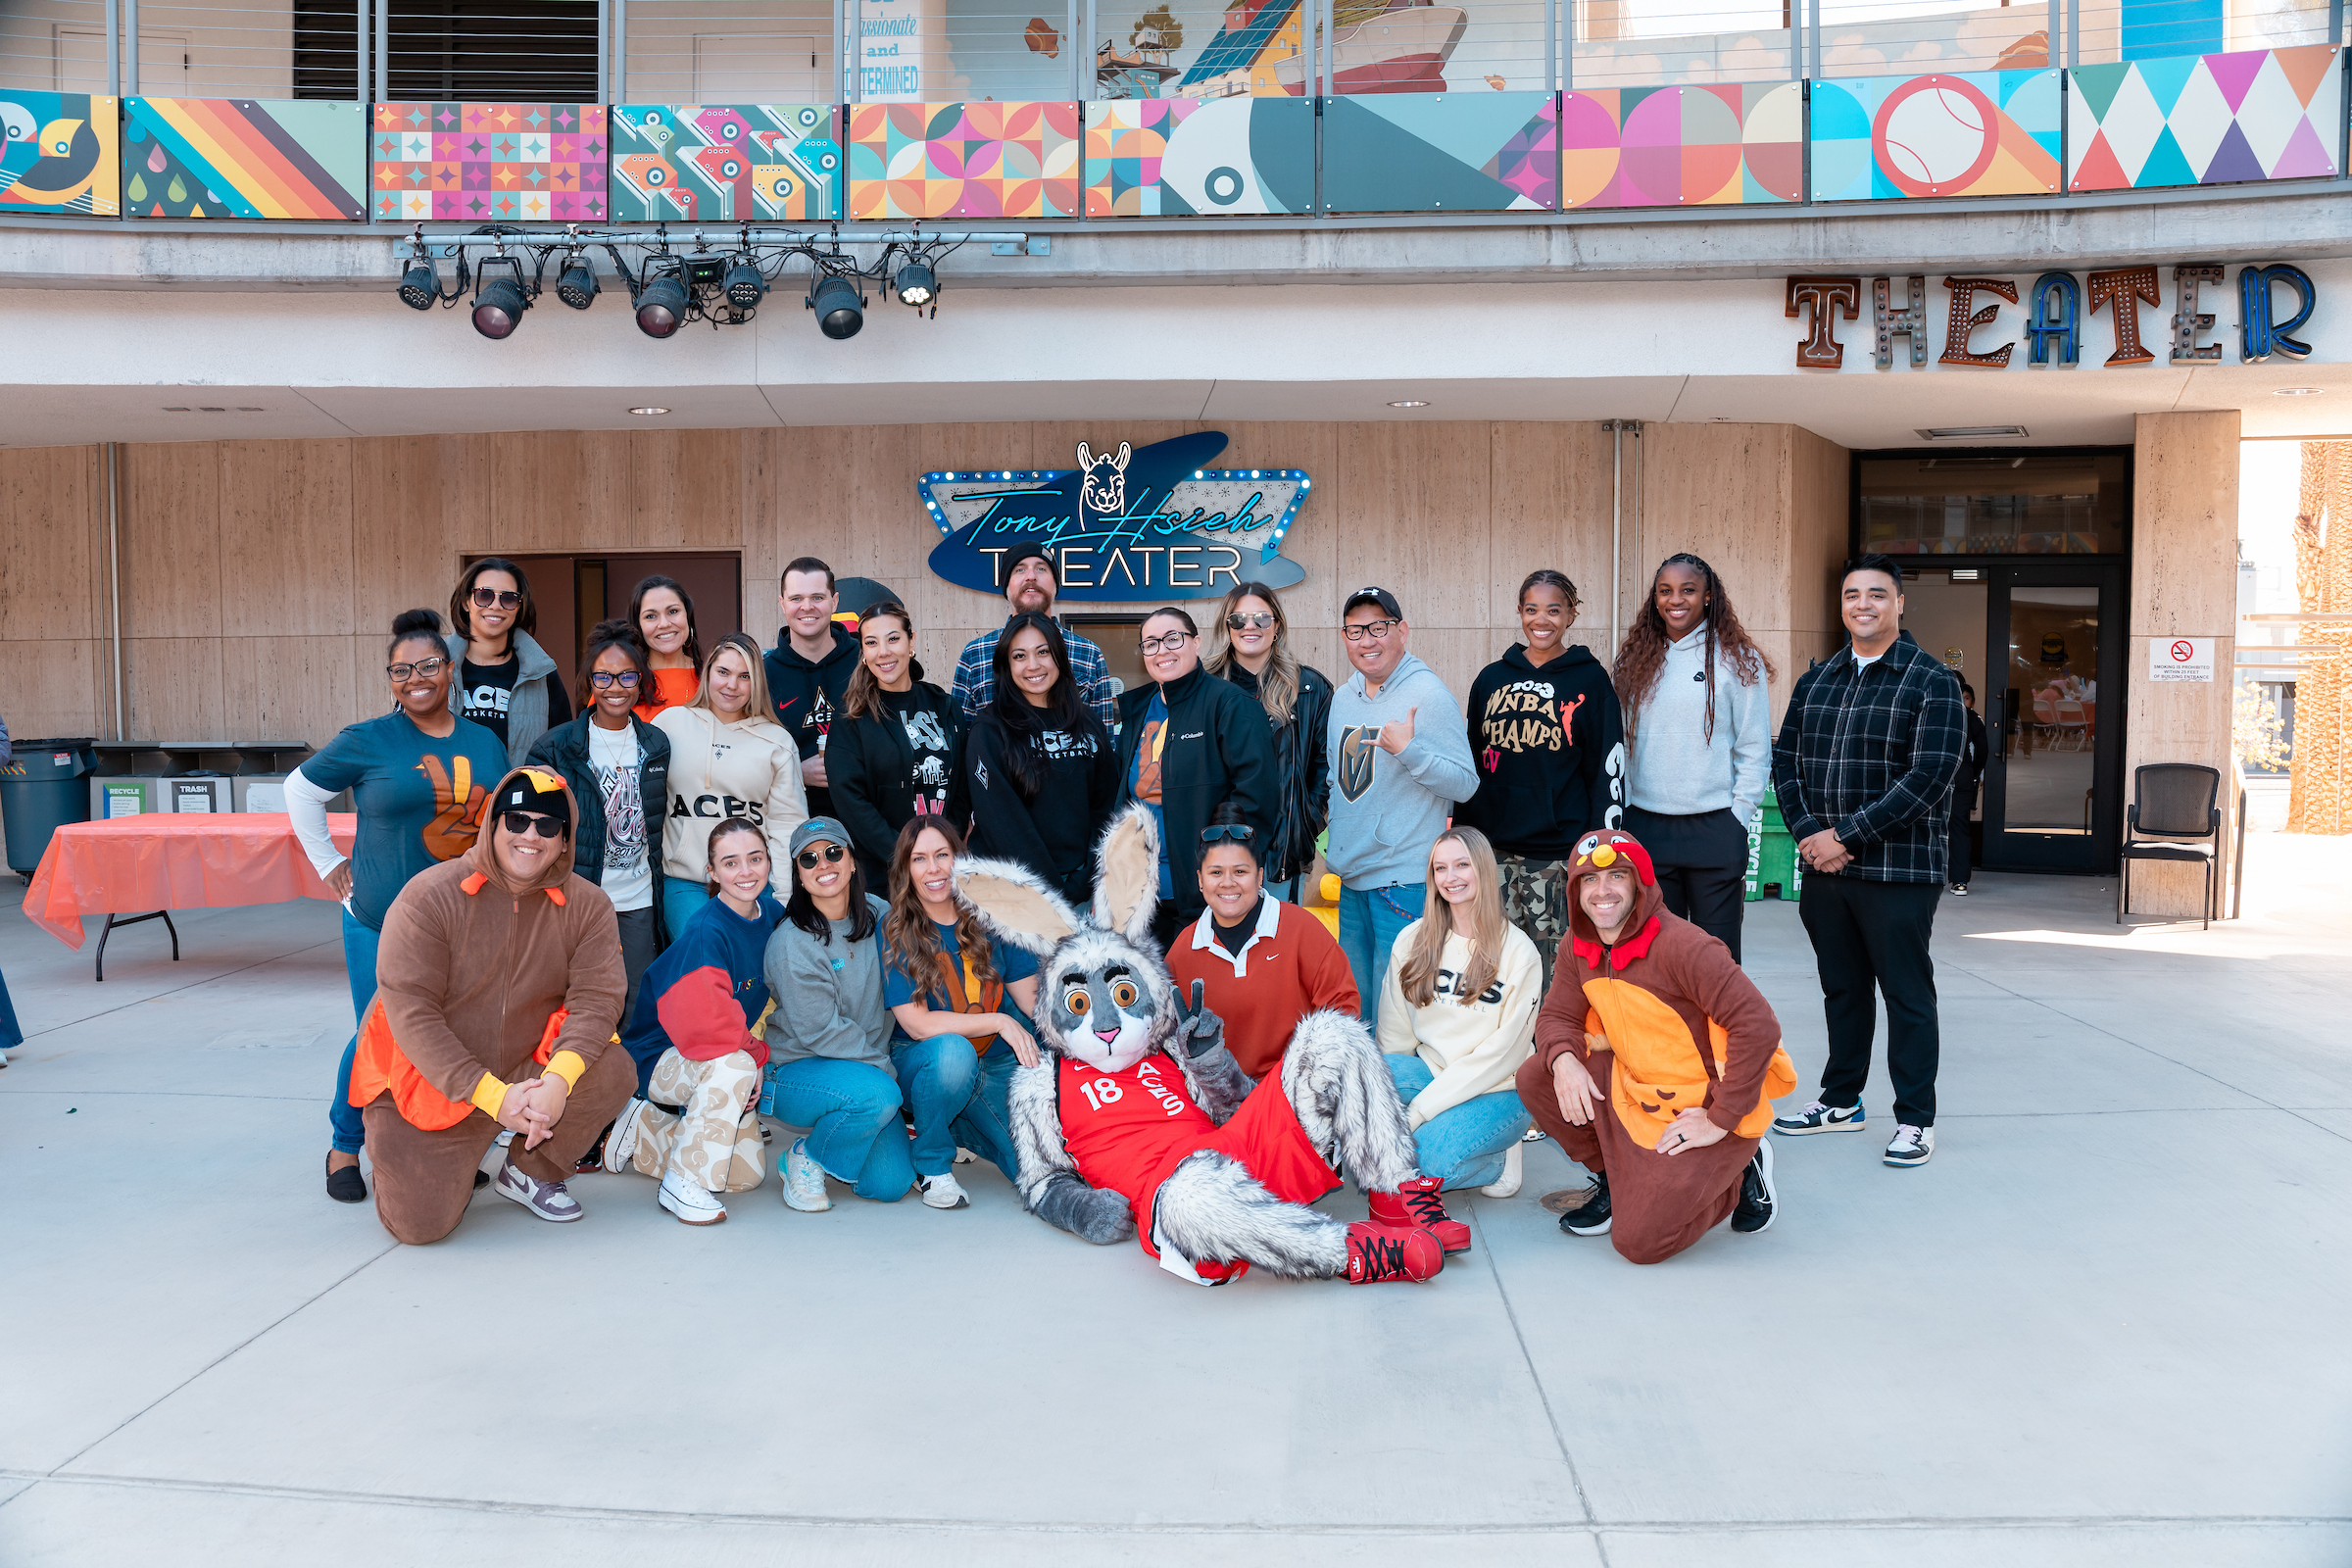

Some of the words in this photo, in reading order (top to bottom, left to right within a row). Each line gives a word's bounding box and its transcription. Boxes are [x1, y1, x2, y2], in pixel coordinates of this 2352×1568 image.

[845, 11, 918, 51] assionate
[866, 43, 900, 57] and
[1786, 264, 2317, 369] THEATER
[953, 488, 1071, 548] Tony
[1097, 486, 1272, 554] Hsieh
[978, 545, 1243, 587] TEATER
[1484, 684, 1558, 724] WNBA
[1510, 680, 1555, 699] 2023
[1481, 718, 1562, 753] CHAMPS
[1482, 748, 1501, 773] LV
[669, 794, 764, 826] ACES
[734, 976, 758, 994] JUST
[1079, 1077, 1124, 1112] 18
[1136, 1060, 1186, 1117] ACES
